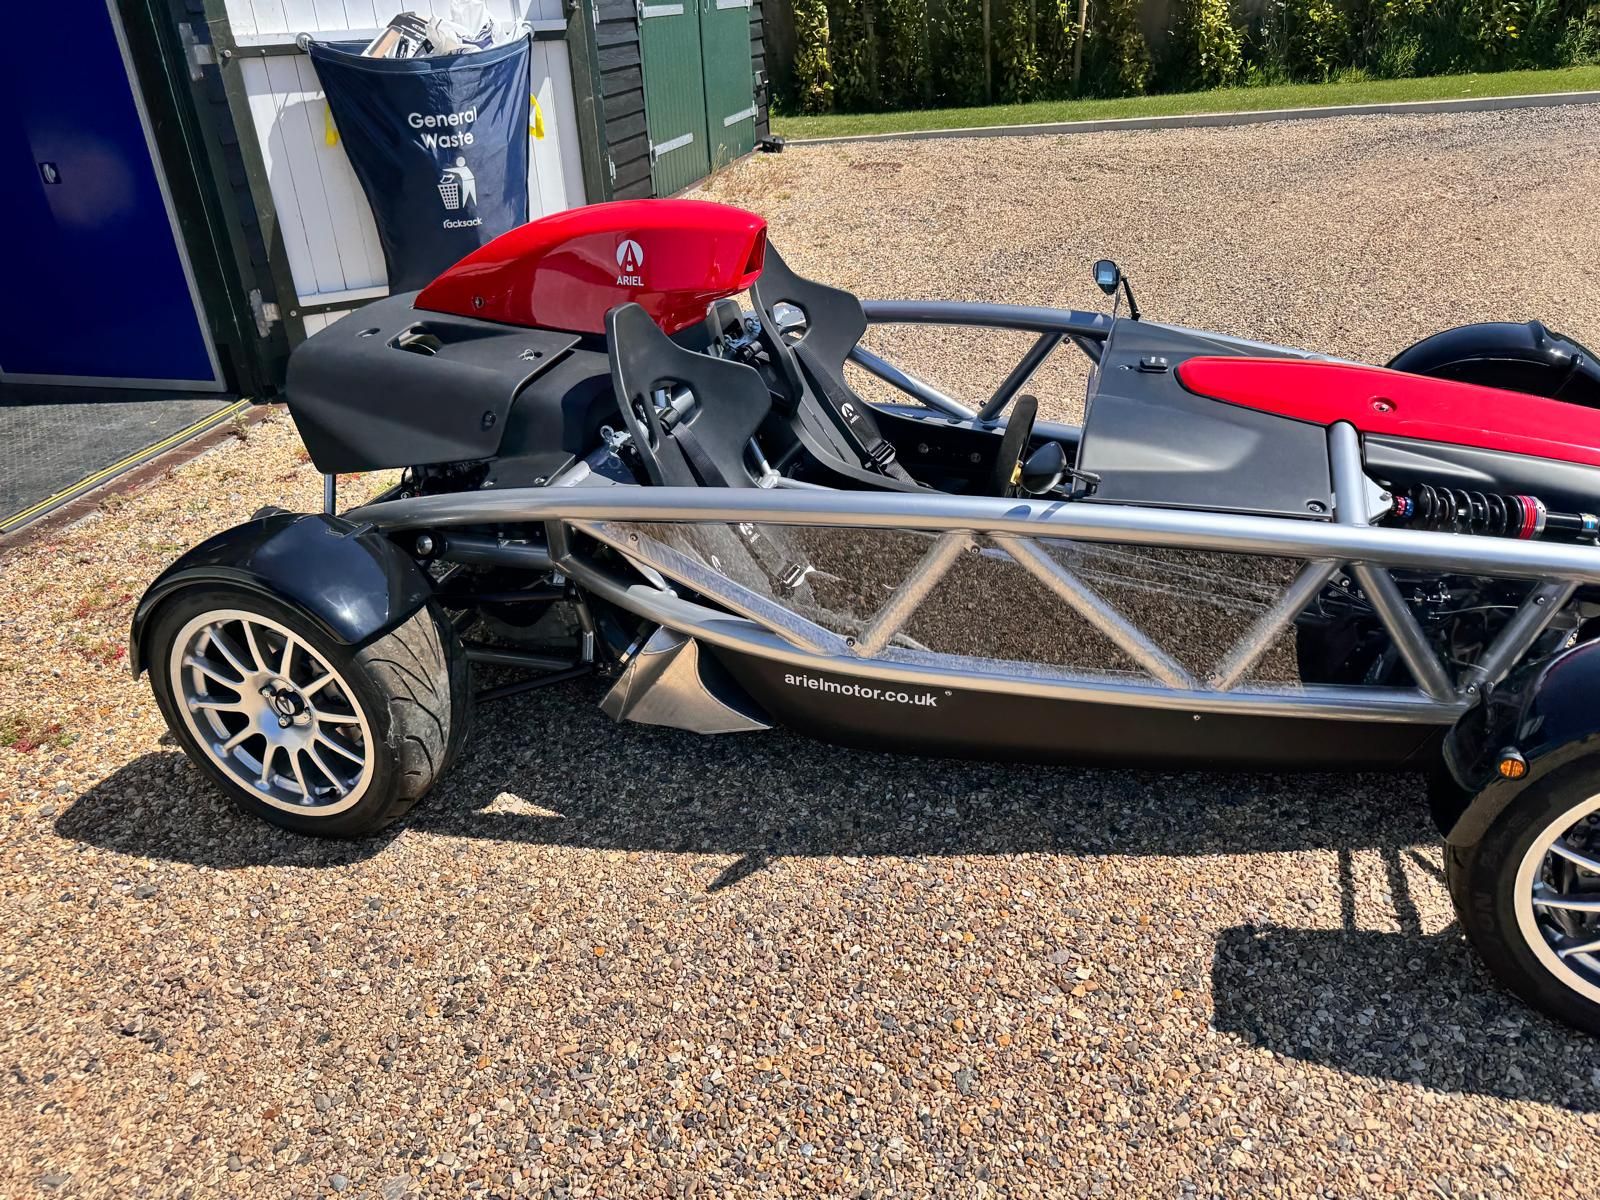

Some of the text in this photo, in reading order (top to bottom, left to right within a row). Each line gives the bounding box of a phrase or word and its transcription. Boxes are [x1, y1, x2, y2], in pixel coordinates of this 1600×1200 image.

[408, 106, 478, 128] General
[421, 131, 474, 149] Waste
[443, 217, 483, 229] racksack
[616, 275, 645, 287] ARIEL
[784, 673, 938, 707] arielmotor.co.uk
